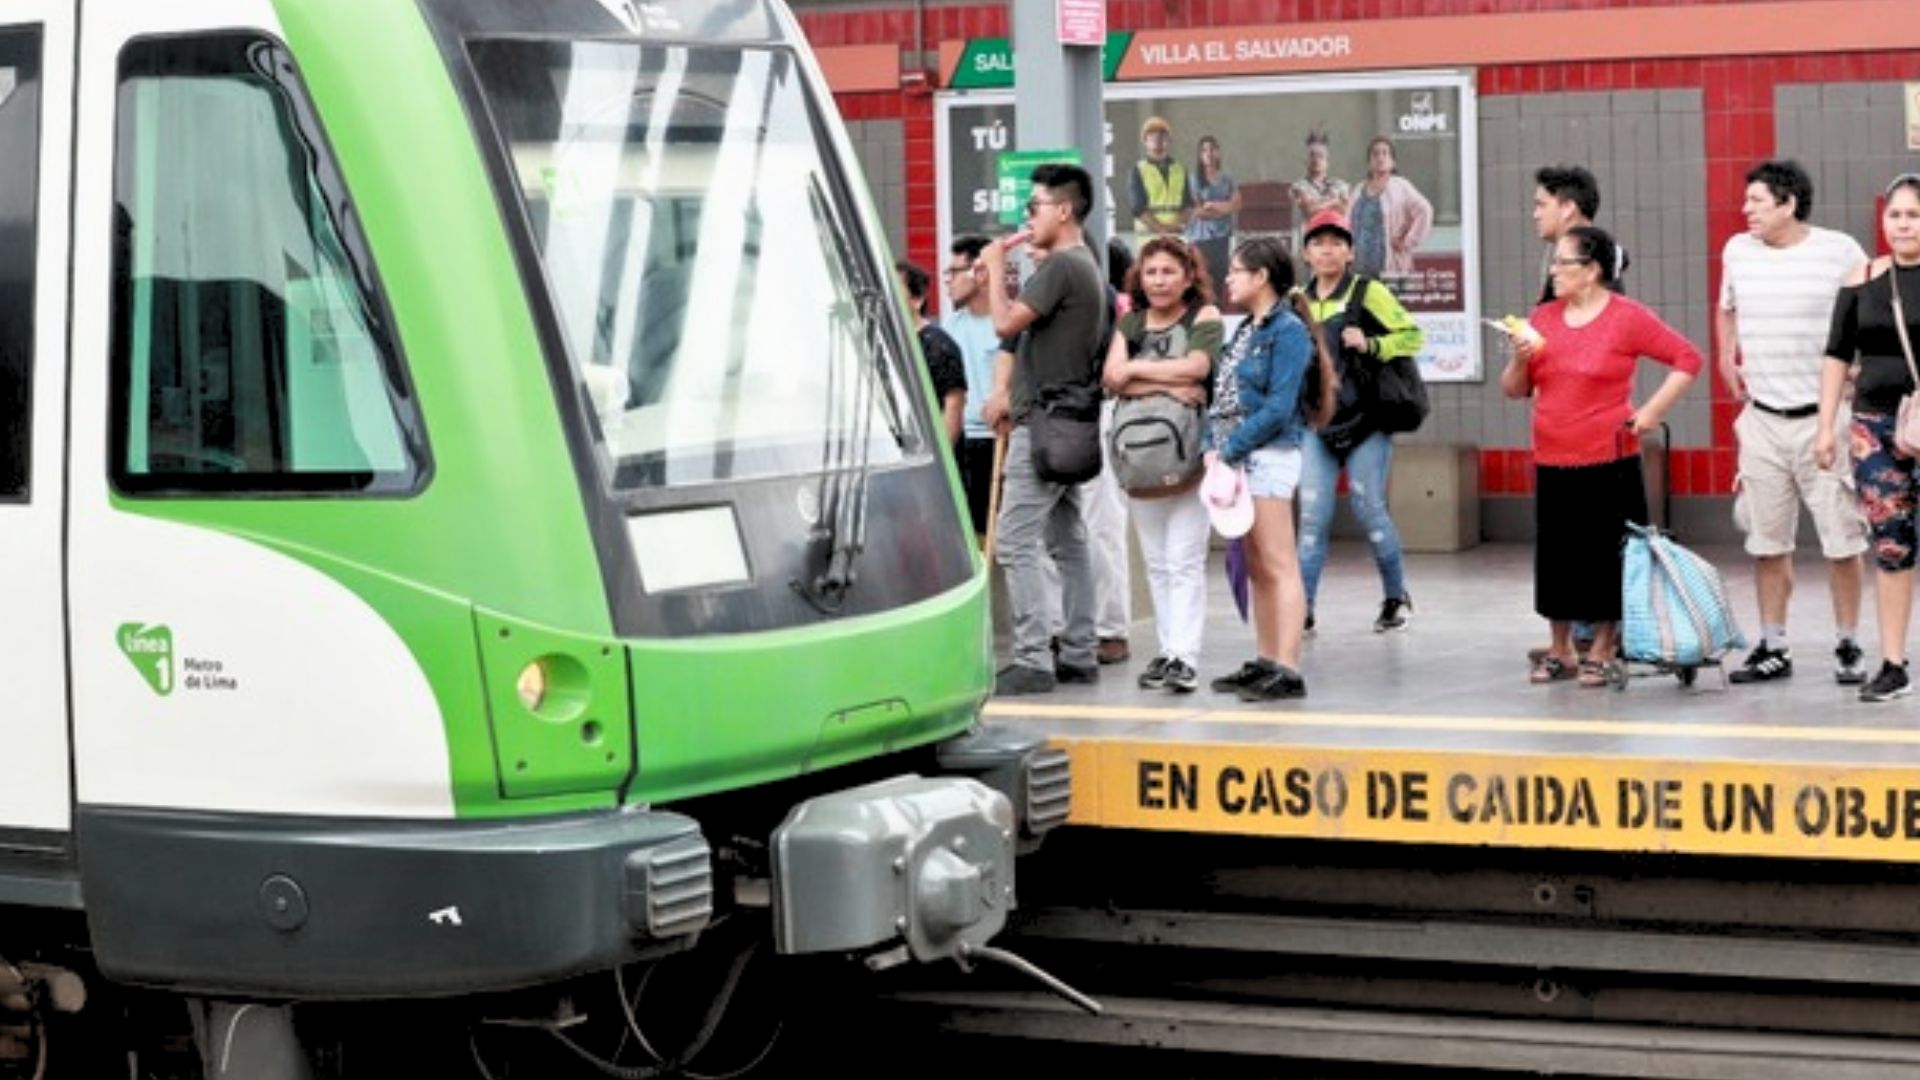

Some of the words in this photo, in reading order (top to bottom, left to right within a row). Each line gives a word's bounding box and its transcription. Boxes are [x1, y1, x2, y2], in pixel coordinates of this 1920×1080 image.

[1140, 42, 1200, 64] VILLA
[1204, 40, 1231, 62] EL
[1235, 35, 1351, 60] SALVADOR
[155, 656, 169, 690] 1
[183, 657, 223, 672] Metro
[184, 674, 202, 690] de
[203, 675, 238, 690] Lima
[1137, 760, 1198, 811] EN
[1216, 766, 1349, 818] CASO
[1366, 770, 1429, 822] DE
[1446, 772, 1600, 828] CAIDA
[1617, 777, 1683, 832] DE
[1703, 781, 1774, 835] UN
[1794, 785, 1920, 842] OBJE
